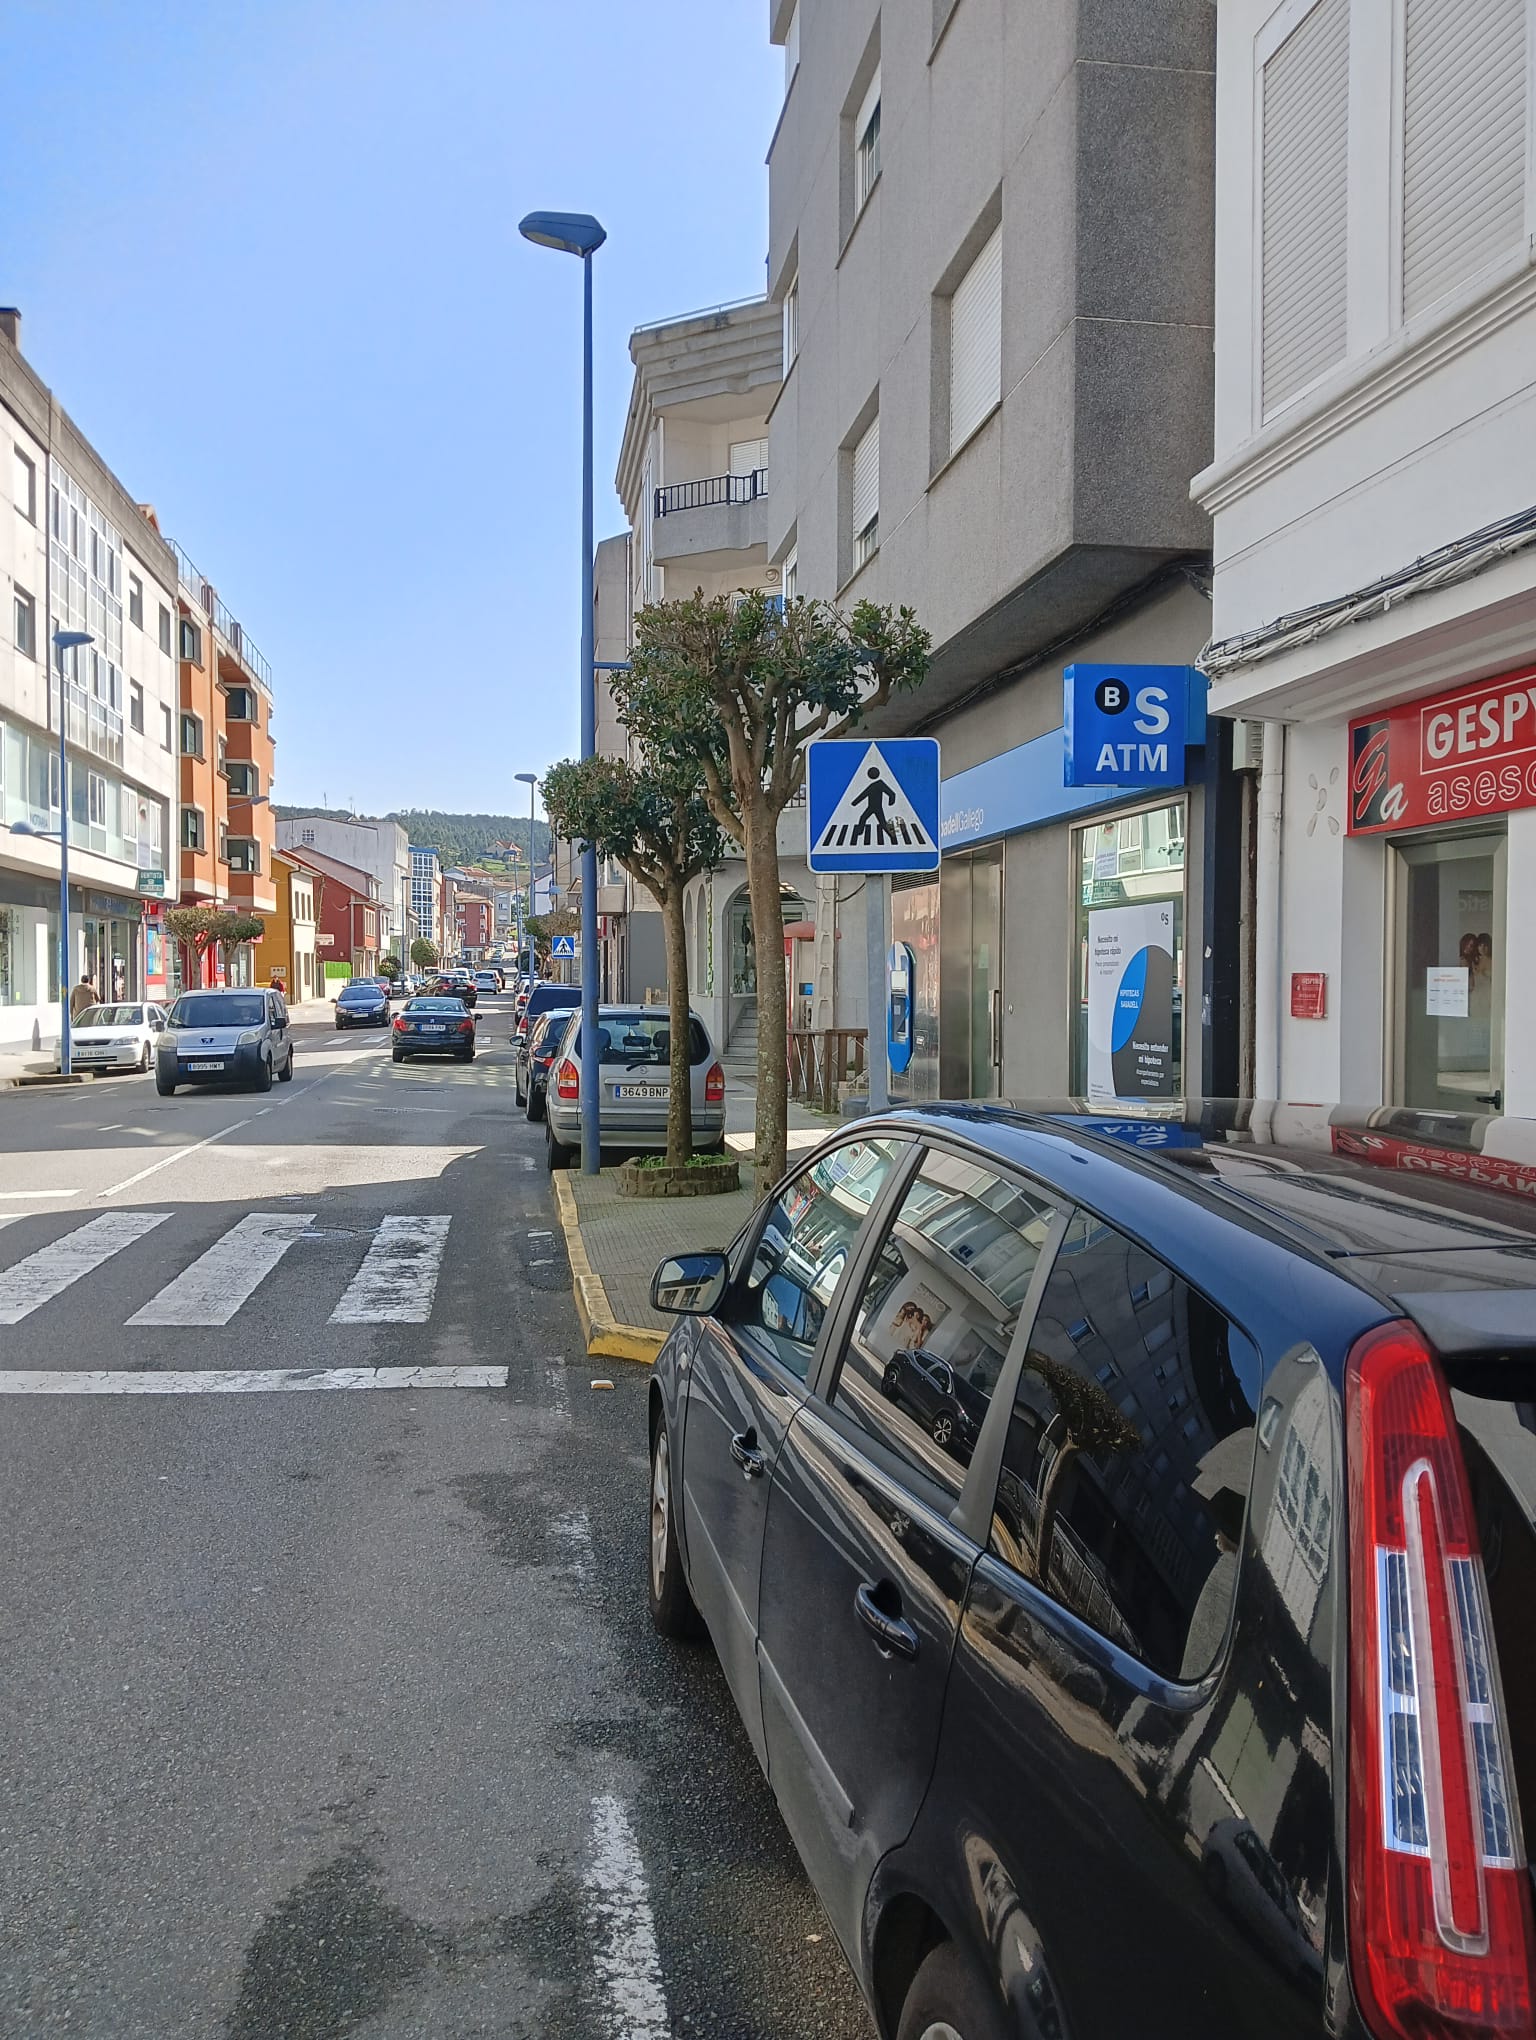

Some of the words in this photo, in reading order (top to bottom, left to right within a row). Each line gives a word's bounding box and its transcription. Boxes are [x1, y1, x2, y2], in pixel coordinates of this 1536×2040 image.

[1133, 686, 1170, 735] S
[1095, 743, 1168, 772] ATM
[622, 1087, 648, 1097] 3649
[649, 1087, 669, 1097] BNP
